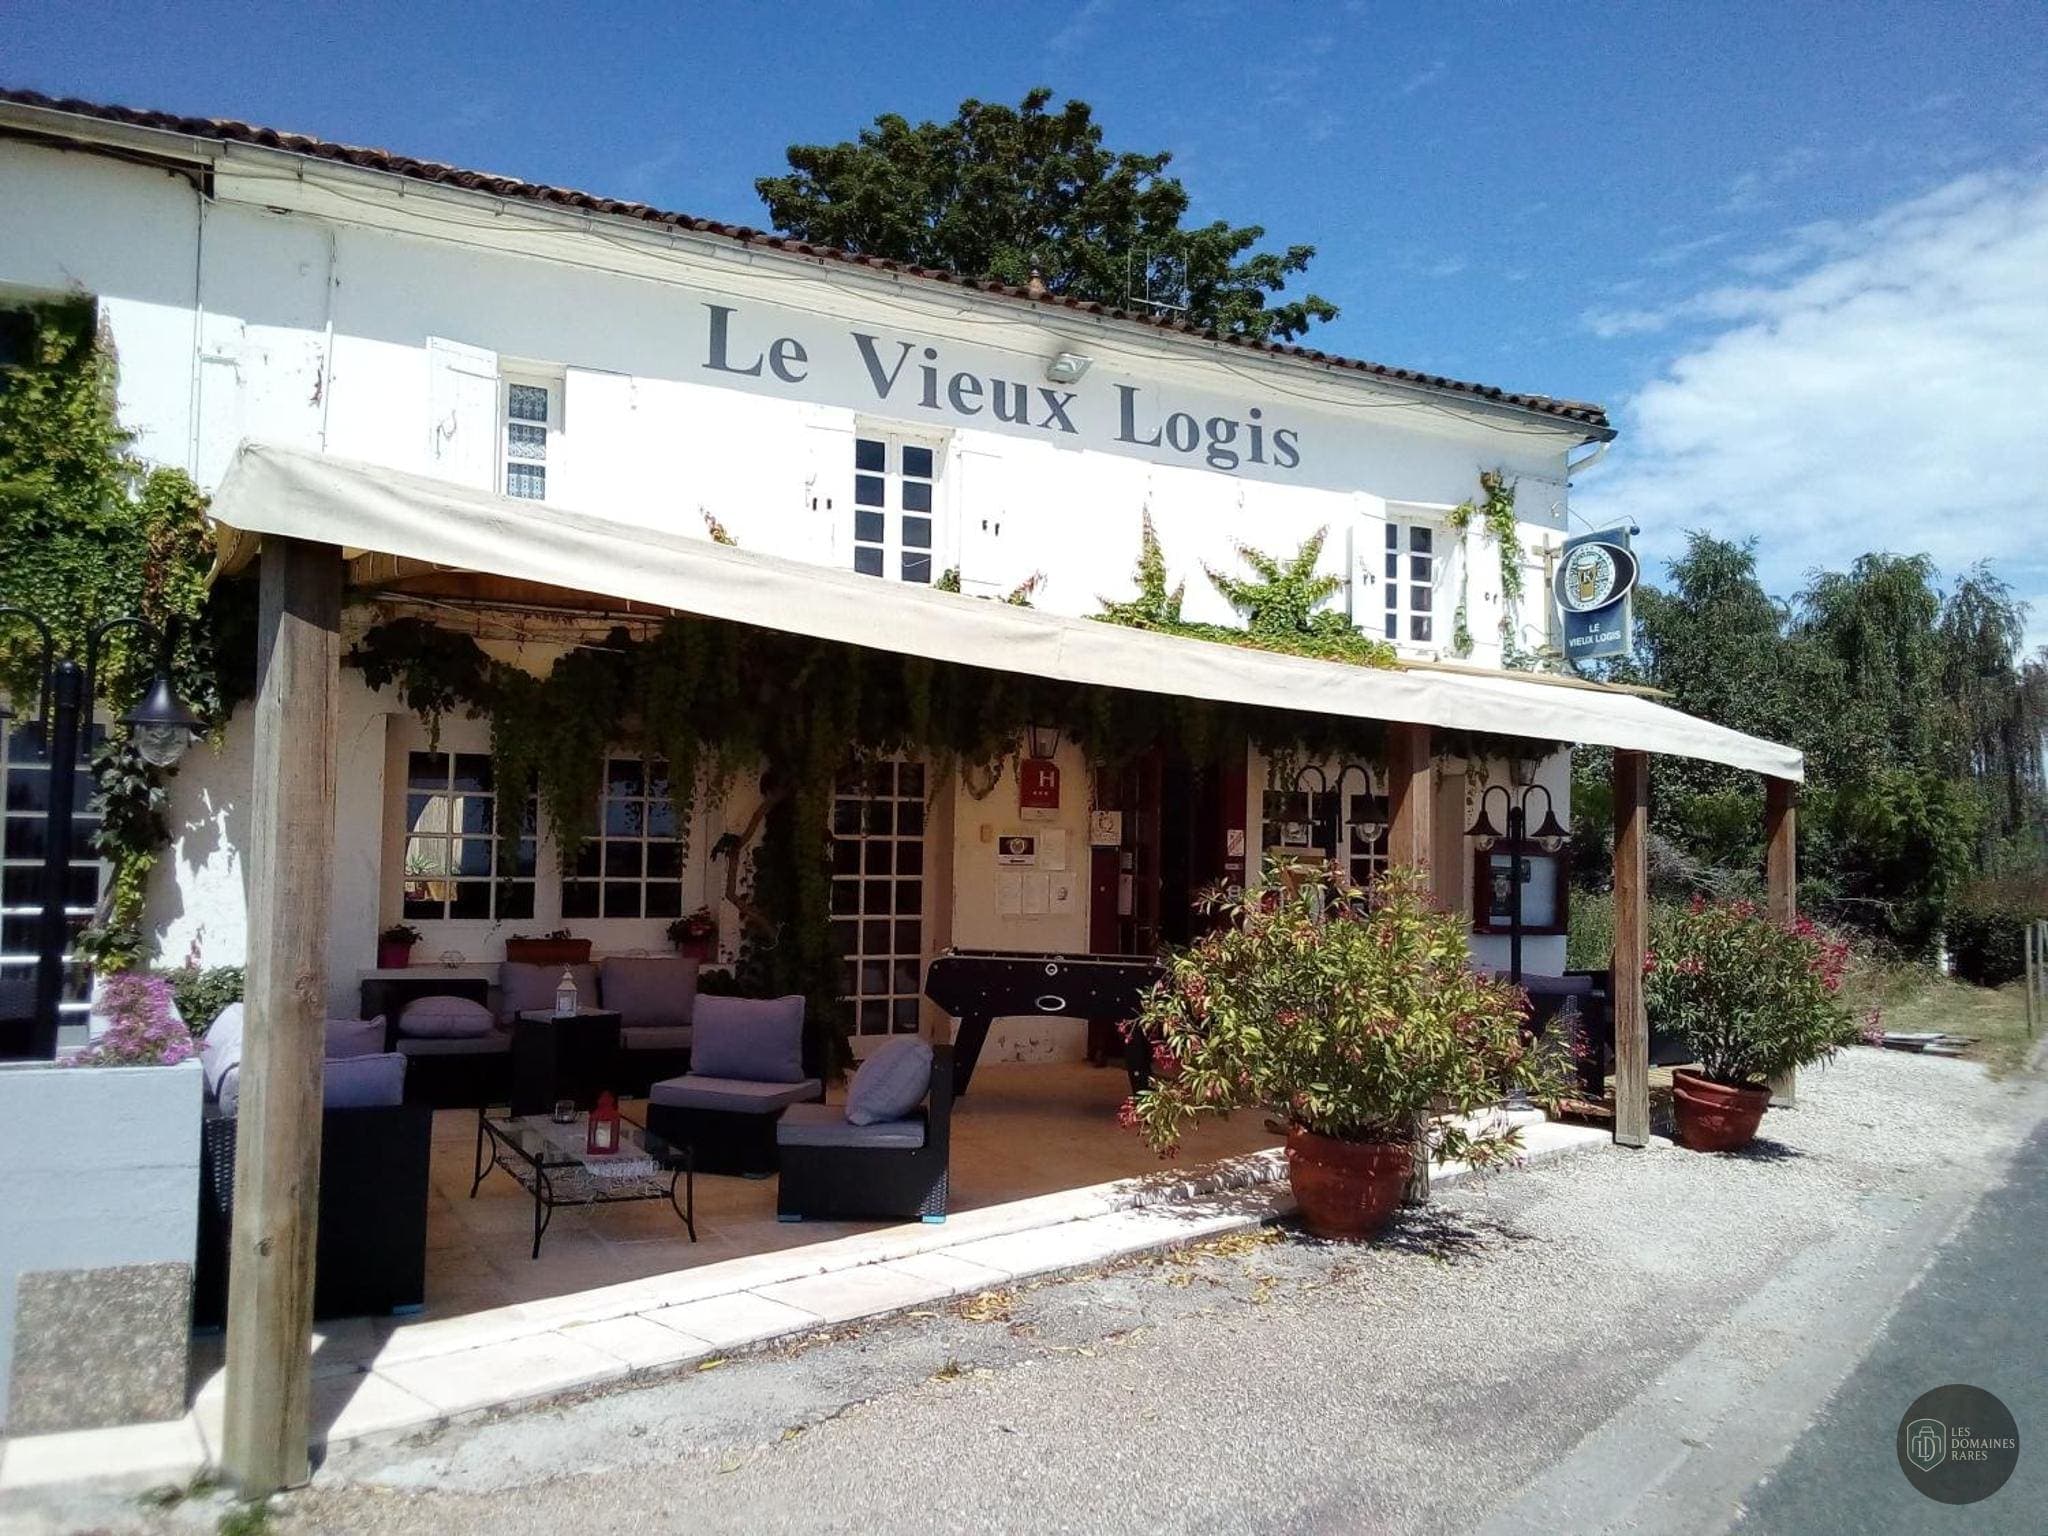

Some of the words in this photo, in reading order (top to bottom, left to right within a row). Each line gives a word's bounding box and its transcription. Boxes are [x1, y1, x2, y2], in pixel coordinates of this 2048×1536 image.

[701, 303, 808, 382] Le
[850, 331, 1080, 434] Vieux
[1113, 383, 1301, 469] Logis
[1589, 623, 1600, 633] LE
[1569, 635, 1594, 647] VIEUX
[1595, 630, 1621, 643] LOGIS
[1039, 770, 1055, 788] H
